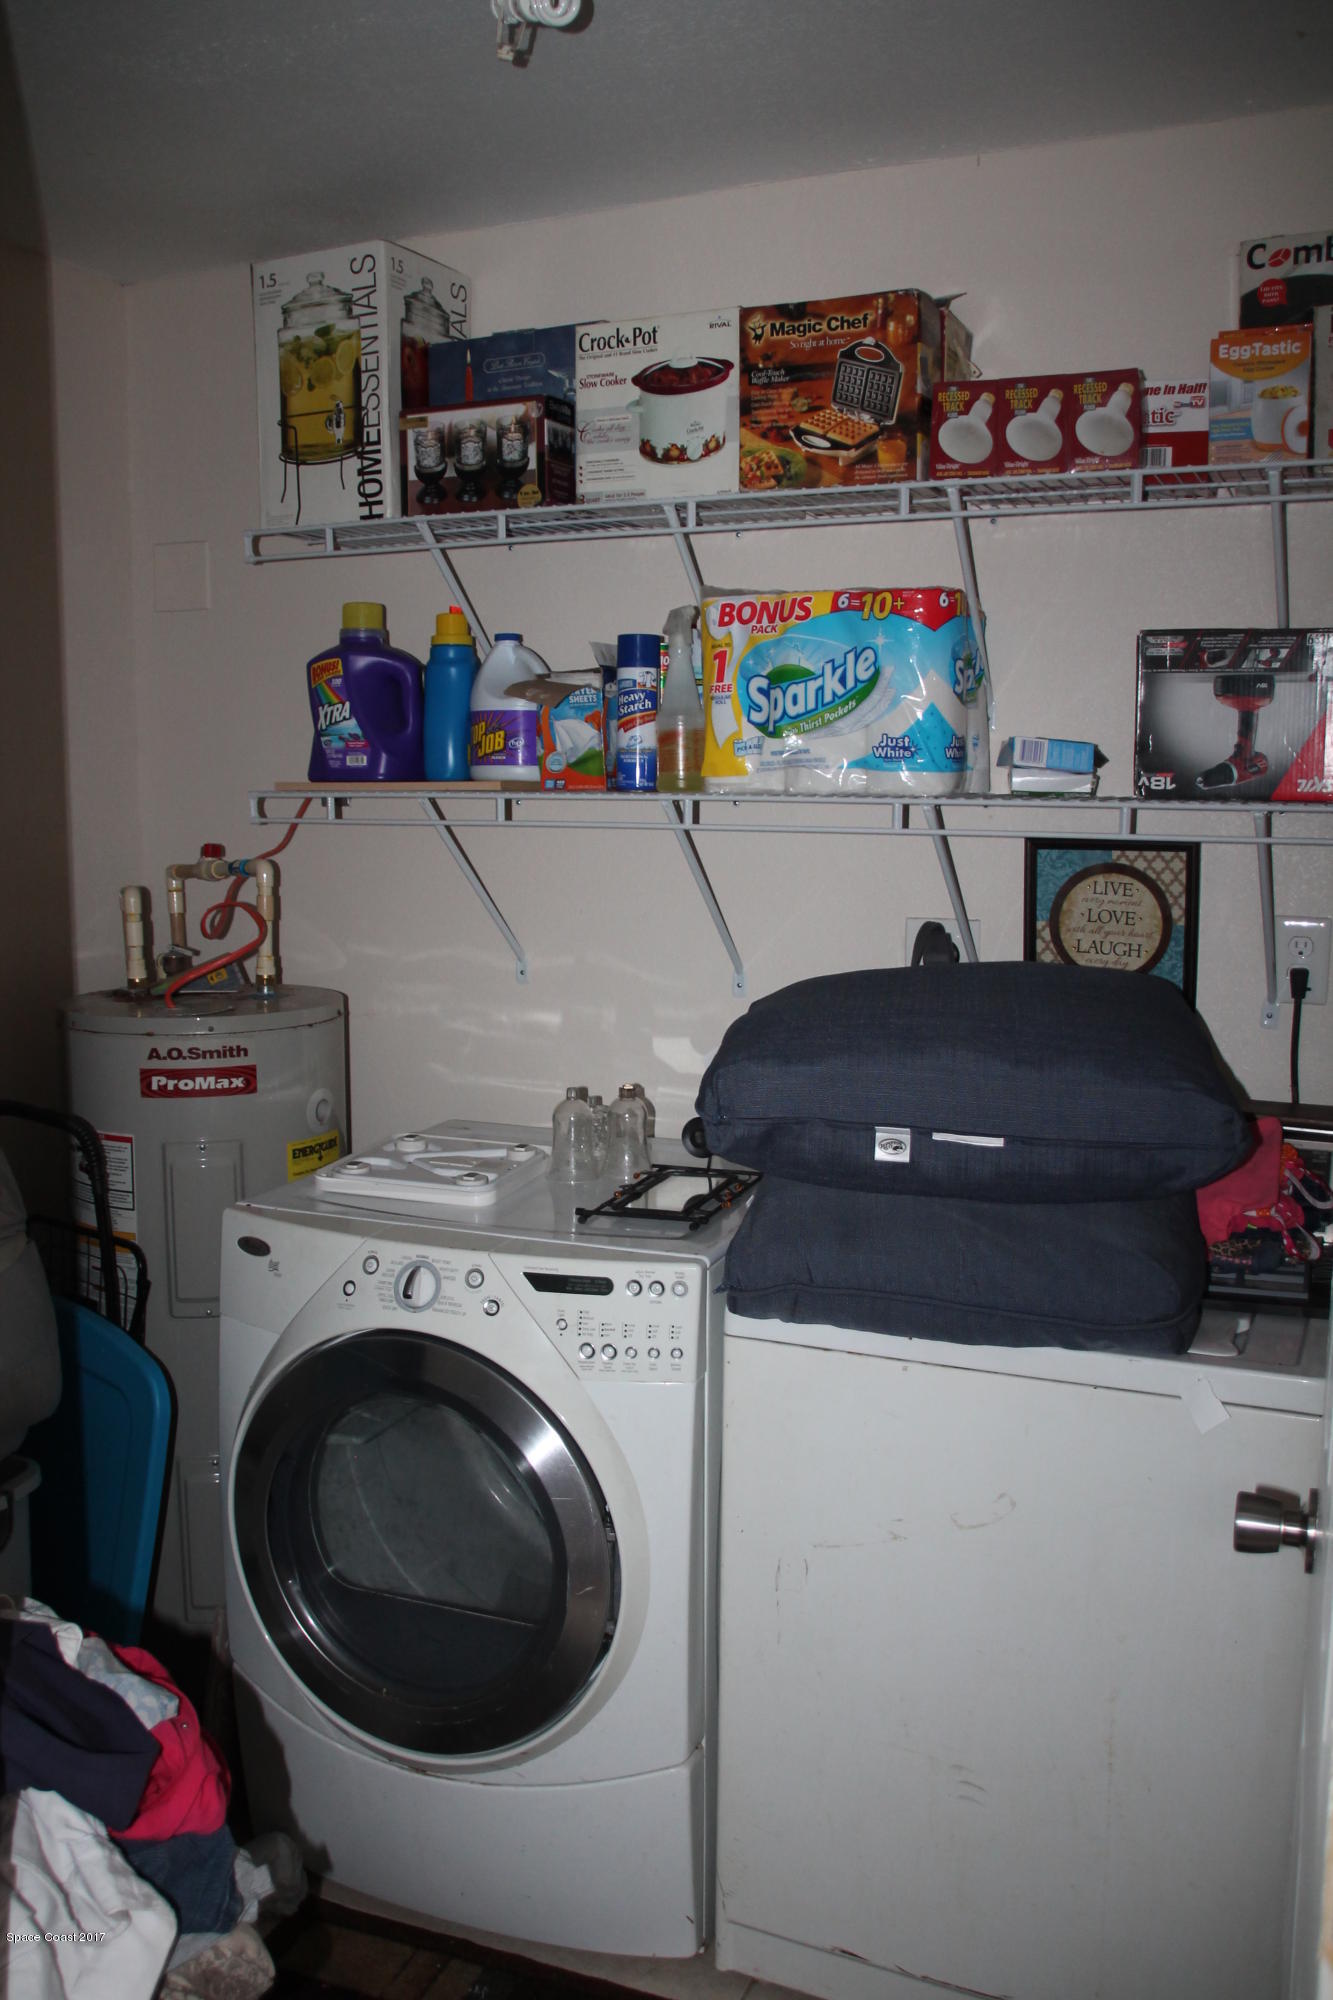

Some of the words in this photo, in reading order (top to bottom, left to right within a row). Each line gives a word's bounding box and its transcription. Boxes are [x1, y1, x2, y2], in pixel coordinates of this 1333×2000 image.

[259, 272, 278, 289] 1.5
[770, 319, 823, 337] Magic
[827, 313, 869, 332] Chef
[579, 377, 598, 390] Slow
[599, 375, 627, 387] Cooker
[1073, 381, 1108, 394] RECESSED
[1163, 383, 1176, 395] In
[938, 390, 970, 402] RECESSED
[1005, 388, 1038, 400] RECESSED
[1079, 393, 1102, 404] TRACK
[942, 401, 965, 412] TRACK
[1010, 399, 1033, 410] TRACK
[718, 595, 813, 628] BONUS
[750, 624, 779, 634] PACK
[712, 649, 728, 683] 1
[709, 683, 733, 694] FREE
[748, 646, 878, 733] Sparkle
[568, 694, 598, 704] SHEETS
[618, 691, 646, 705] Heavy
[618, 698, 652, 716] Starch
[318, 700, 351, 731] XTRA
[800, 714, 823, 732] Thirst
[824, 702, 857, 724] Pockets
[472, 721, 486, 745] OP
[880, 733, 910, 747] Just
[477, 729, 506, 758] JOB
[873, 747, 912, 759] White
[1092, 880, 1134, 897] LIVE
[1086, 908, 1137, 926] LOVE
[1076, 938, 1143, 959] LAUGH
[151, 1076, 245, 1091] ProMax
